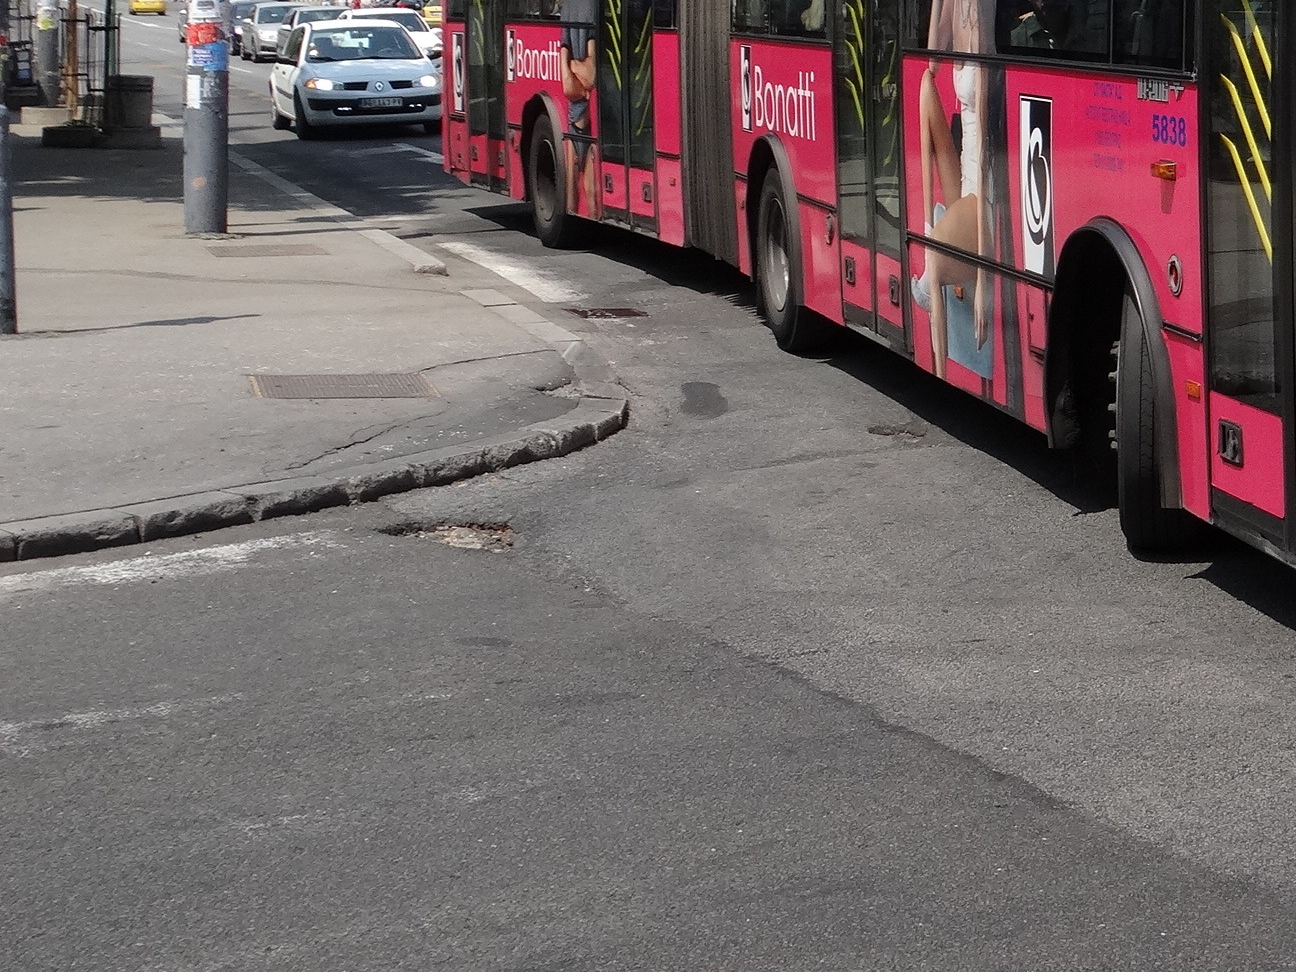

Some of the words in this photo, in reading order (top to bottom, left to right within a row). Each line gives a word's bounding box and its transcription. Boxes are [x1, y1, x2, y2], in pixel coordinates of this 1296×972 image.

[516, 39, 561, 81] Bonatti
[754, 65, 816, 141] Bonatti
[1152, 114, 1187, 147] 5838
